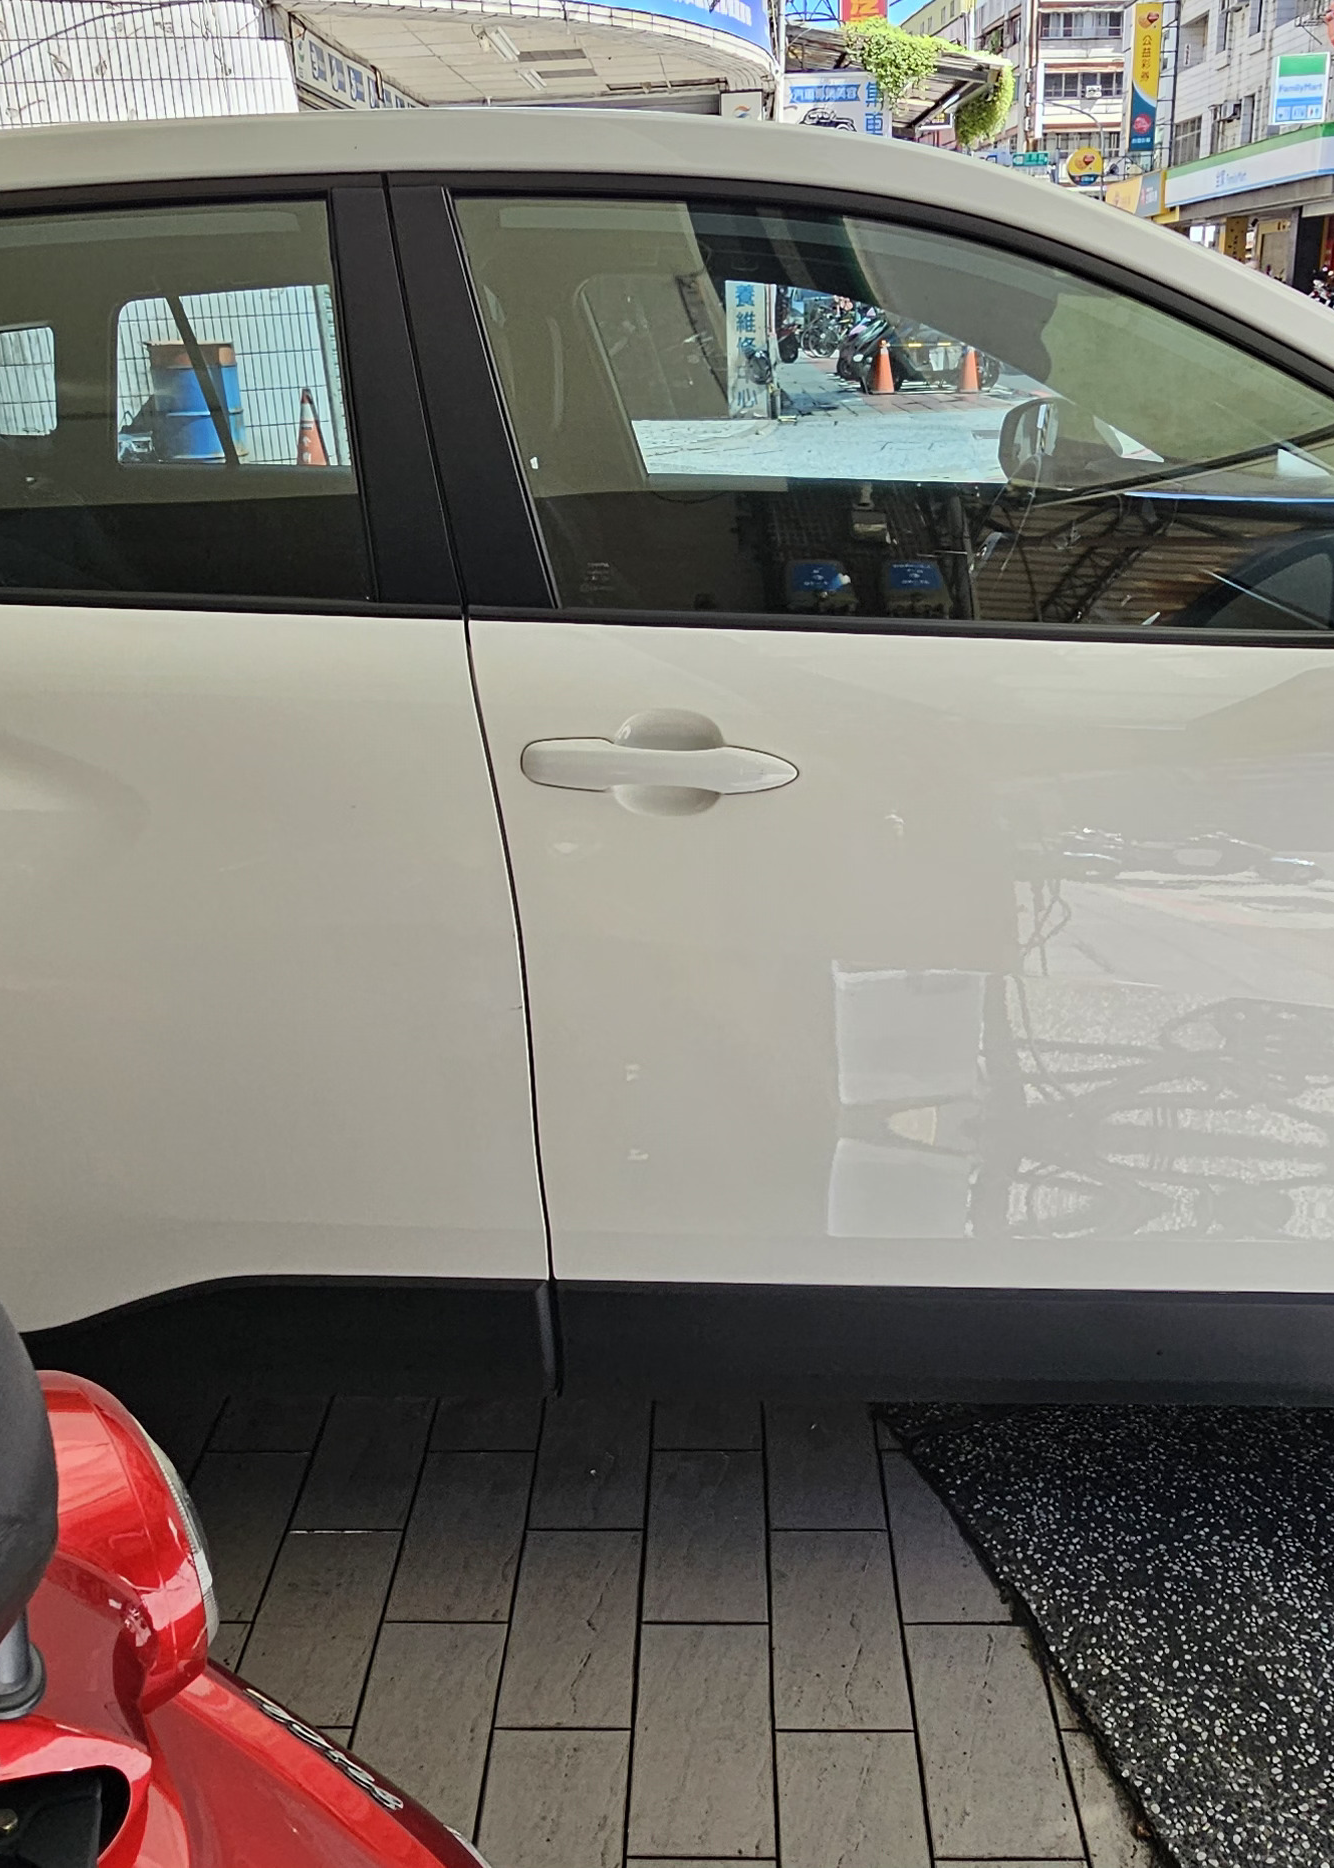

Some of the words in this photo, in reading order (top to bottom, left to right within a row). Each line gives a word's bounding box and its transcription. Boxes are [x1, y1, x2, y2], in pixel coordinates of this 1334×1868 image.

[1140, 35, 1152, 82] 公益彩券
[1279, 82, 1323, 94] FamilyMart
